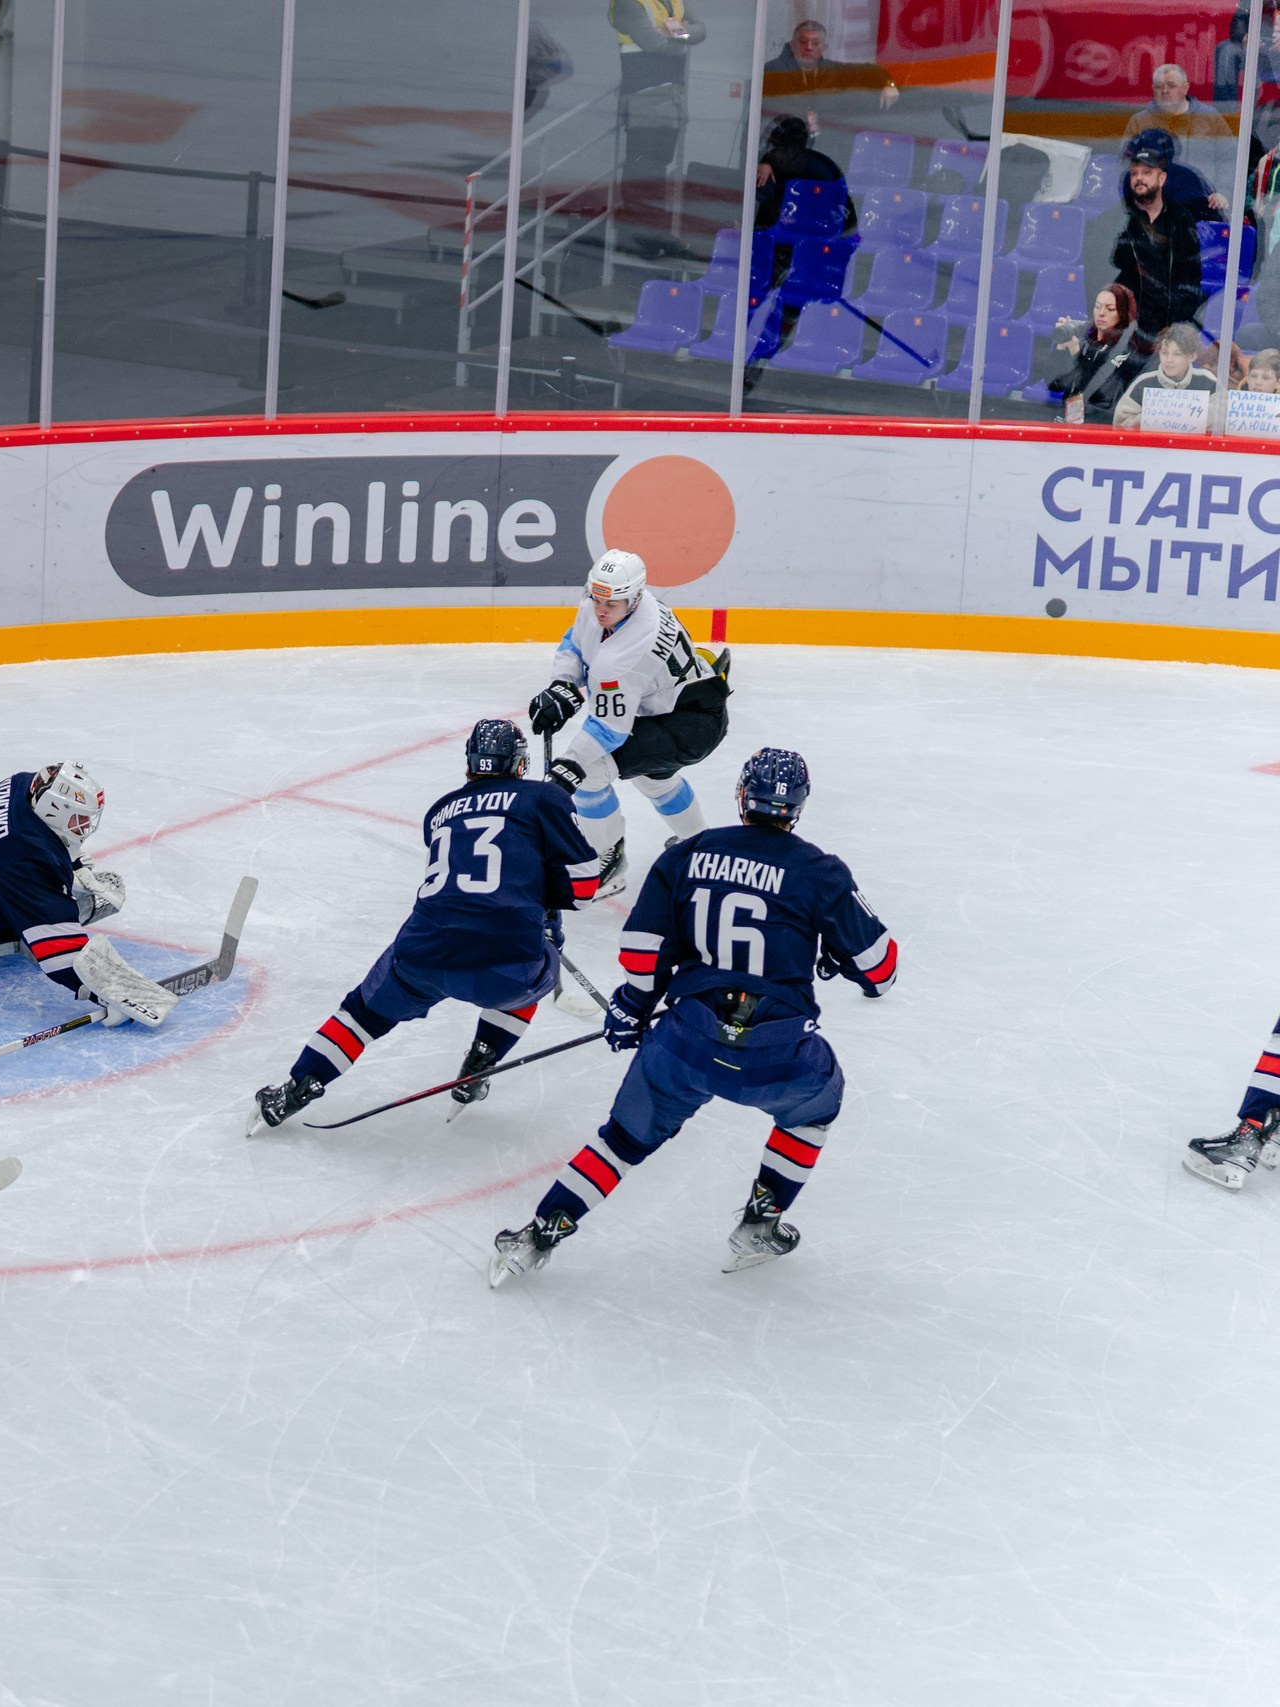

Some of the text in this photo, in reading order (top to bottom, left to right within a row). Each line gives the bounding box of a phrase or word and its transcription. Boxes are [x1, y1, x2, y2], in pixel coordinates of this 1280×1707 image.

[151, 481, 557, 570] Winline
[600, 562, 616, 574] 86
[1033, 533, 1280, 602] МЫТИ
[595, 693, 626, 718] 86
[479, 758, 493, 771] 93
[775, 781, 788, 796] 16
[430, 791, 518, 832] SHMELYOV
[418, 815, 506, 899] 93
[688, 852, 785, 895] KHARKIN
[690, 887, 768, 977] 16
